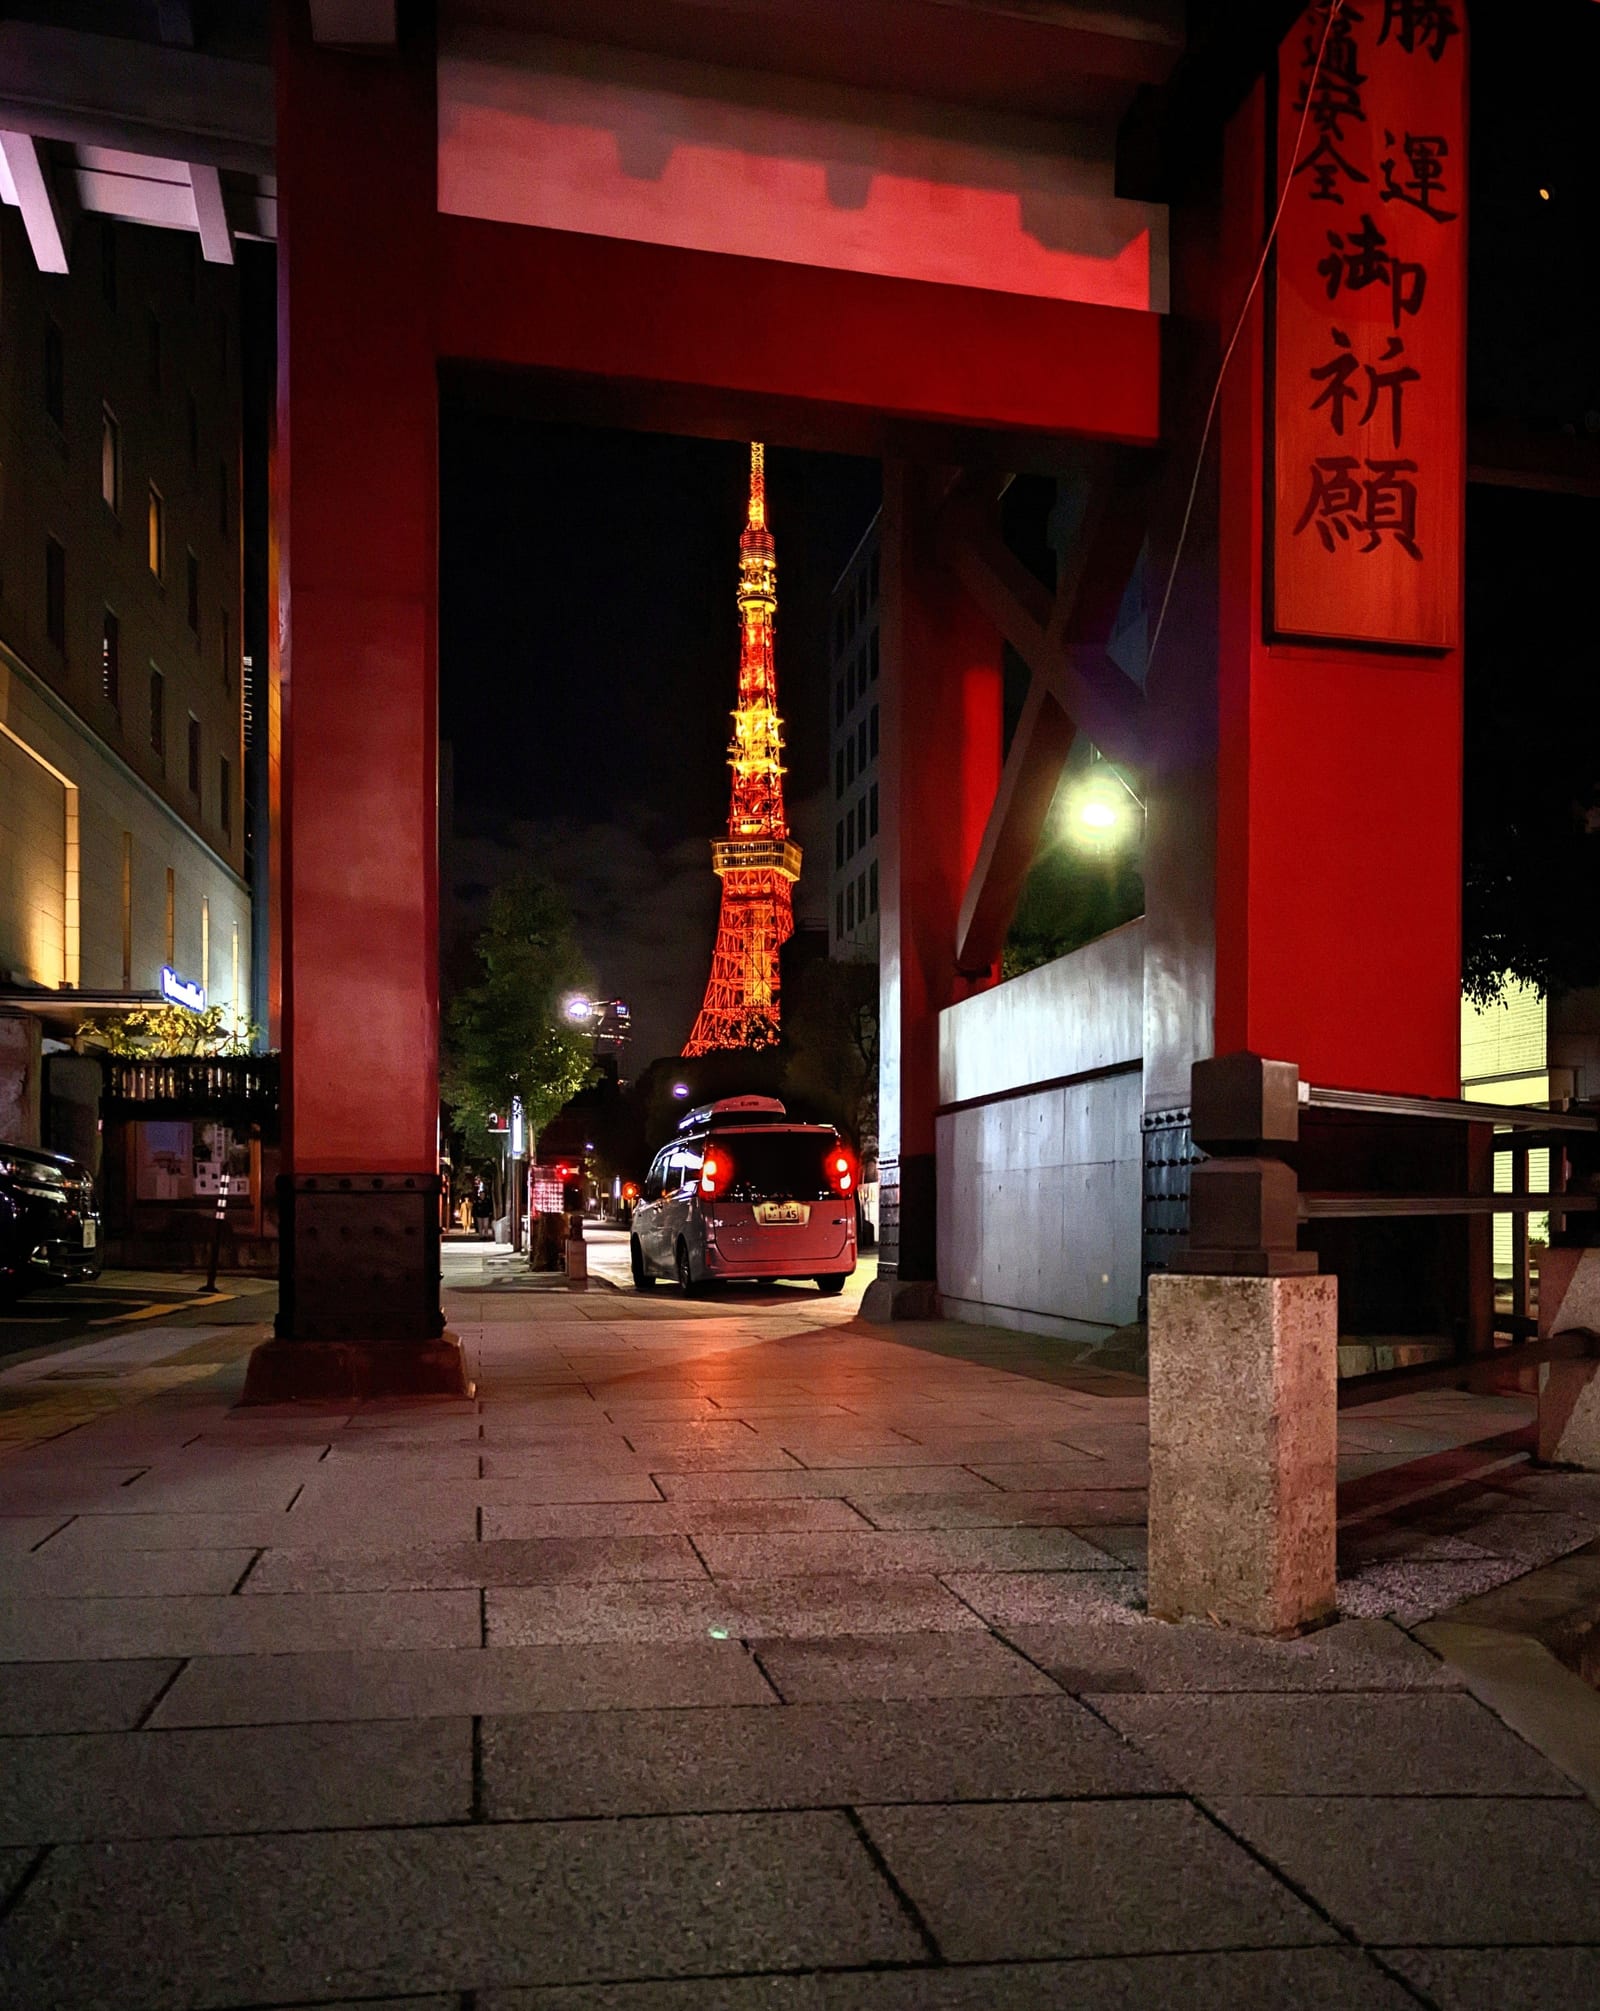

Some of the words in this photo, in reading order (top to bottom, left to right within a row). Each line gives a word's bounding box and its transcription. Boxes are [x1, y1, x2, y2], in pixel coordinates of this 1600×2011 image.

[1292, 0, 1369, 205] 通安全
[1293, 213, 1427, 561] 御祈願
